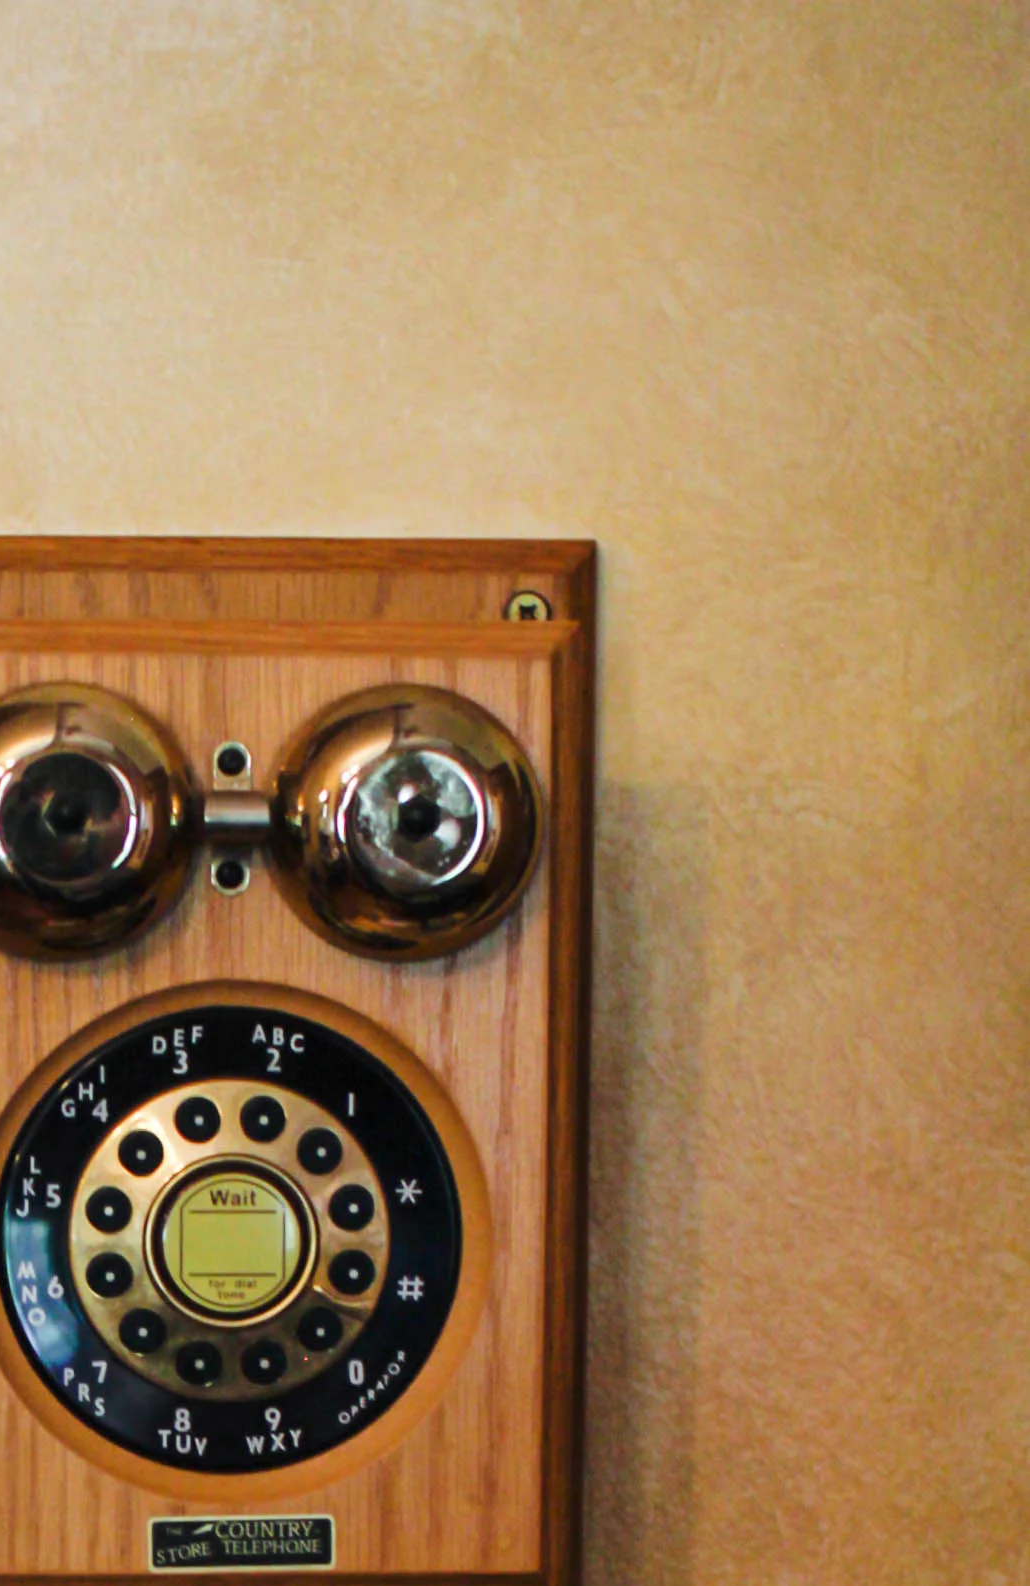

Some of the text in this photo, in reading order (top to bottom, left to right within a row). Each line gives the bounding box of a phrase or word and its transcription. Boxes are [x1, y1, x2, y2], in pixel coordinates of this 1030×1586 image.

[152, 1025, 203, 1055] DEF
[252, 1024, 305, 1053] ABC
[172, 1050, 189, 1075] 3
[266, 1048, 282, 1073] 2
[92, 1098, 109, 1123] 4
[46, 1184, 62, 1209] 5
[210, 1189, 257, 1207] Wait
[47, 1275, 65, 1300] 6
[92, 1360, 108, 1384] 7
[348, 1359, 365, 1386] 0
[174, 1407, 191, 1433] 8
[264, 1407, 282, 1431] 9
[158, 1429, 208, 1457] TUV
[246, 1428, 302, 1456] WXY
[214, 1519, 314, 1539] COUNTRY
[156, 1538, 323, 1565] STORE TELEPHONE
